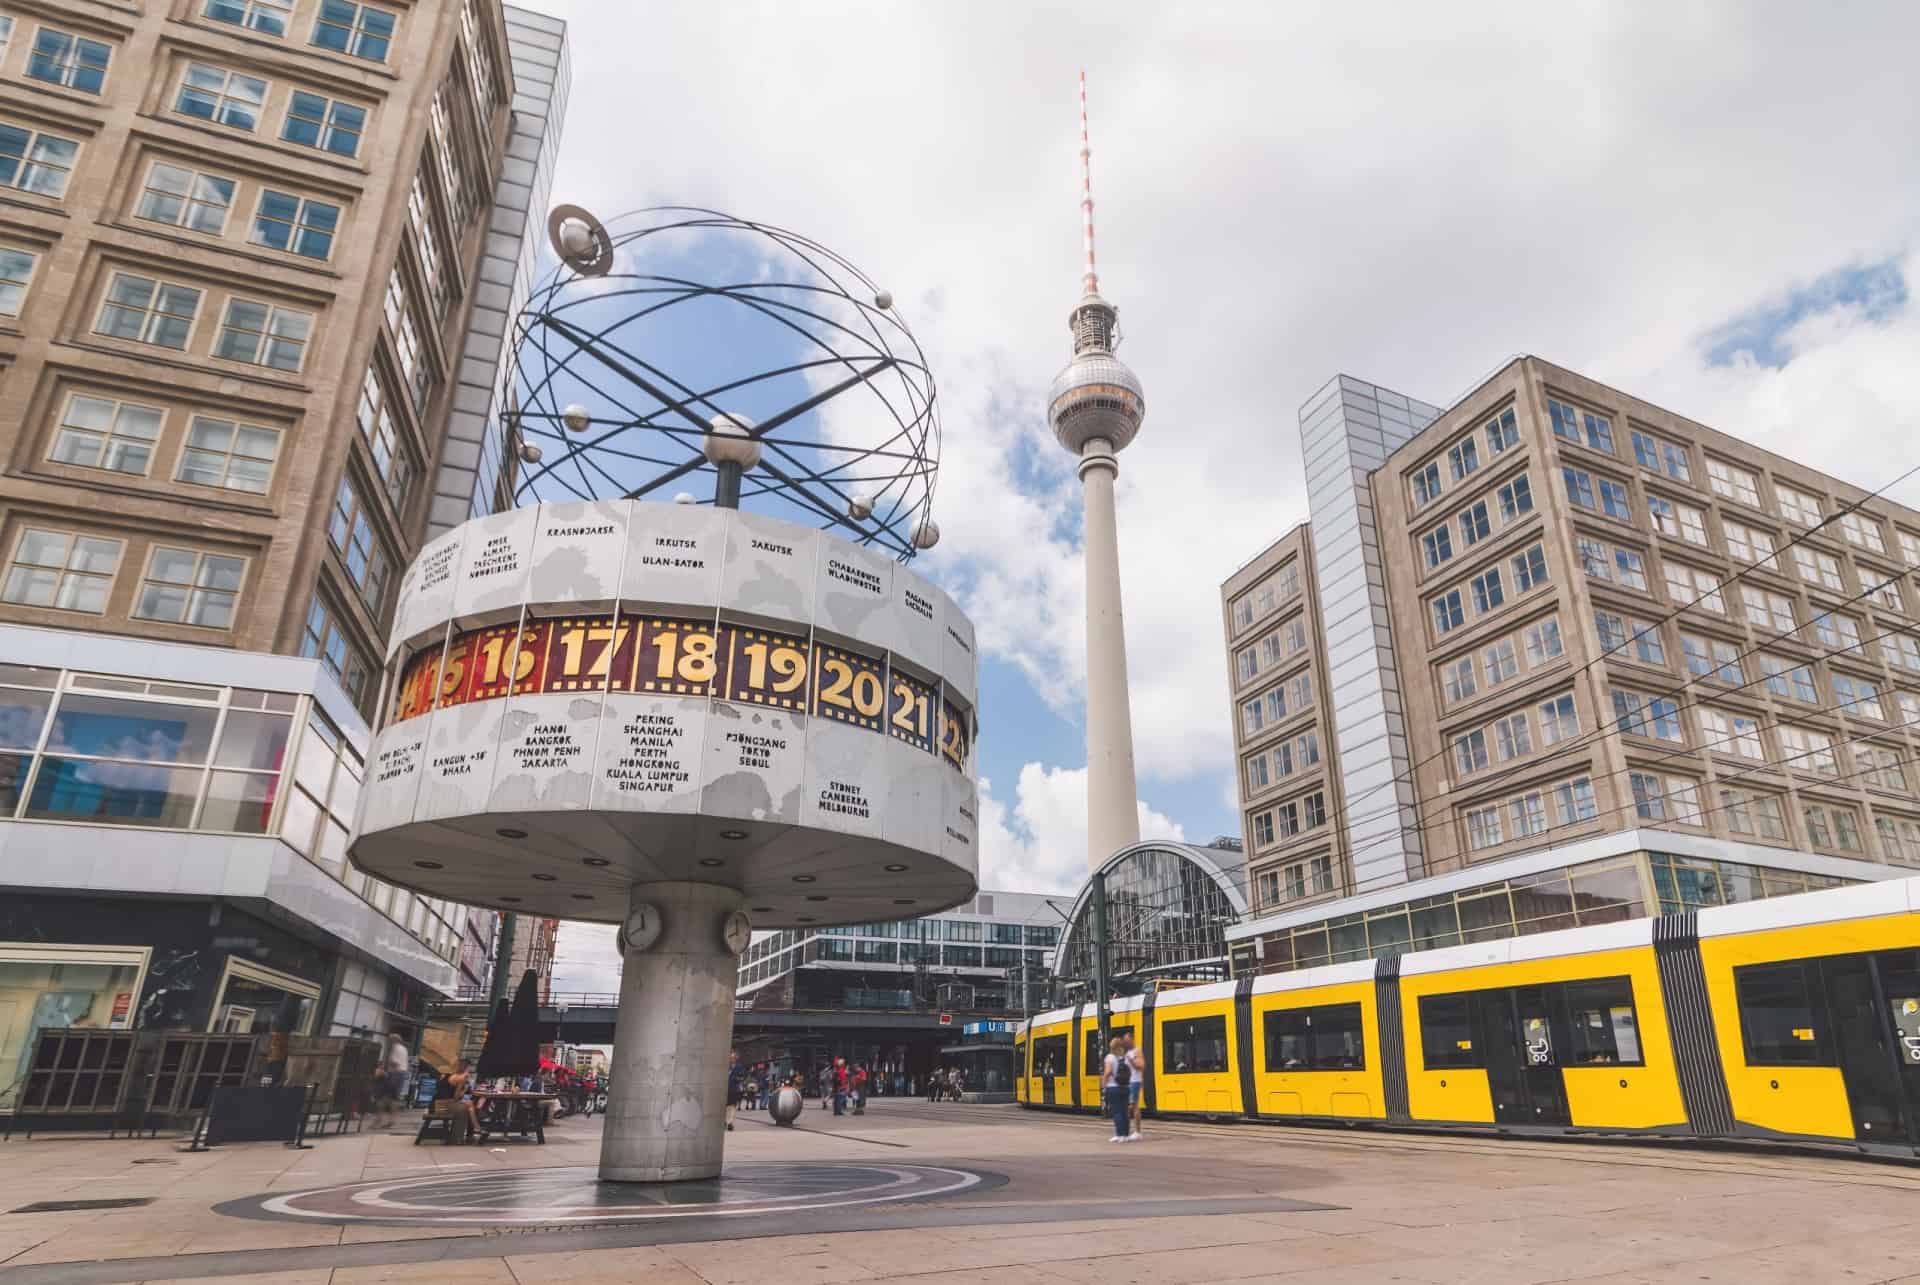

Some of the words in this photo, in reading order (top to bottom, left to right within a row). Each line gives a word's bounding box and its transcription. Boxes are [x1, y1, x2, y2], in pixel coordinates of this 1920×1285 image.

[656, 537, 697, 549] IRKUTSK
[751, 540, 793, 556] JAKUTSK
[642, 556, 705, 569] ULAN-BATOR
[482, 631, 537, 683] 16
[560, 628, 630, 677] 17
[652, 631, 718, 682] 18
[743, 642, 807, 694] 19
[820, 659, 884, 717] 20
[892, 684, 928, 738] 21
[636, 714, 674, 725] PEKING
[534, 724, 567, 734] HANOI
[623, 725, 683, 737] SHANGHAI
[526, 735, 572, 745] BANGKOK
[631, 737, 673, 747] MANILA
[513, 747, 549, 757] PHNOM
[554, 746, 582, 756] PENH
[634, 748, 667, 758] PERTH
[741, 745, 771, 757] TOKYO
[521, 758, 568, 768] JAKARTA
[620, 758, 680, 770] HONGKONG
[739, 756, 770, 769] SEOUL
[606, 769, 642, 779] KUALA
[647, 769, 689, 782] LUMPUR
[618, 781, 674, 792] SINGAPUR
[830, 781, 861, 795] SYDNEY
[821, 790, 868, 807] CANBERRA
[819, 800, 870, 819] MELBOURNE
[988, 1021, 996, 1032] U
